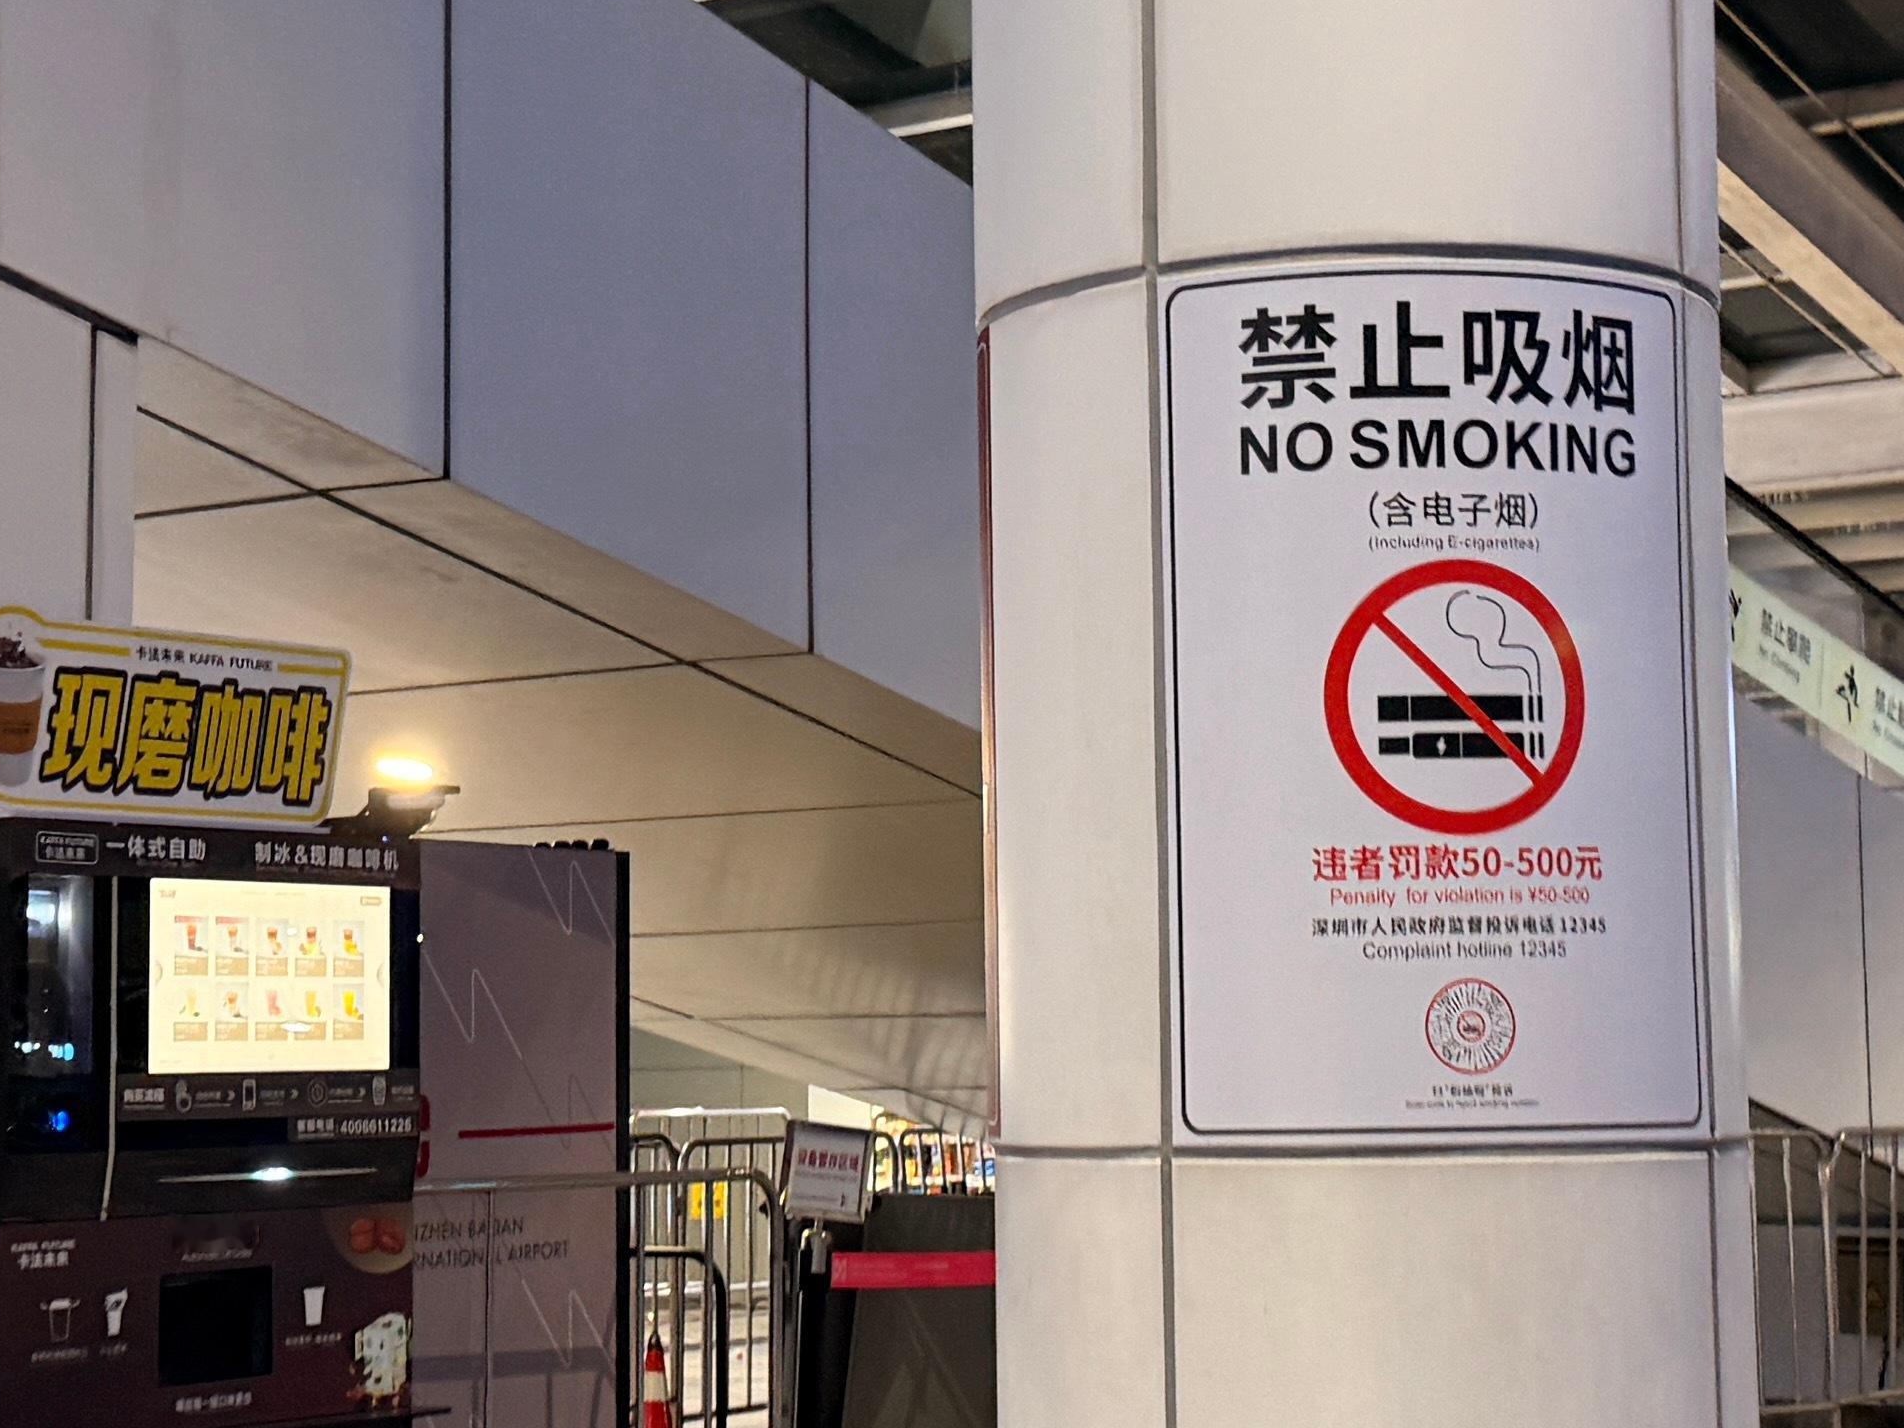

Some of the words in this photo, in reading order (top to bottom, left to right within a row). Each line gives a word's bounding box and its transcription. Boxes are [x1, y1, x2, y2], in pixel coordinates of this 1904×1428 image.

[1239, 301, 1635, 414] 禁止吸烟
[1240, 421, 1333, 475] NO
[1350, 419, 1636, 477] SMOKING
[40, 667, 331, 805] 现磨咖啡
[106, 834, 206, 861] 一体式自助
[1313, 845, 1603, 881] 违者罚款50-500元
[1330, 887, 1396, 908] Penalty
[1406, 886, 1428, 903] for
[1435, 886, 1504, 903] violation
[1510, 886, 1523, 902] is
[1560, 916, 1607, 935] 12345
[1363, 940, 1452, 962] Complaint
[1457, 940, 1513, 959] hotline
[1521, 940, 1567, 958] 12345
[507, 1240, 568, 1261] AIRPORT
